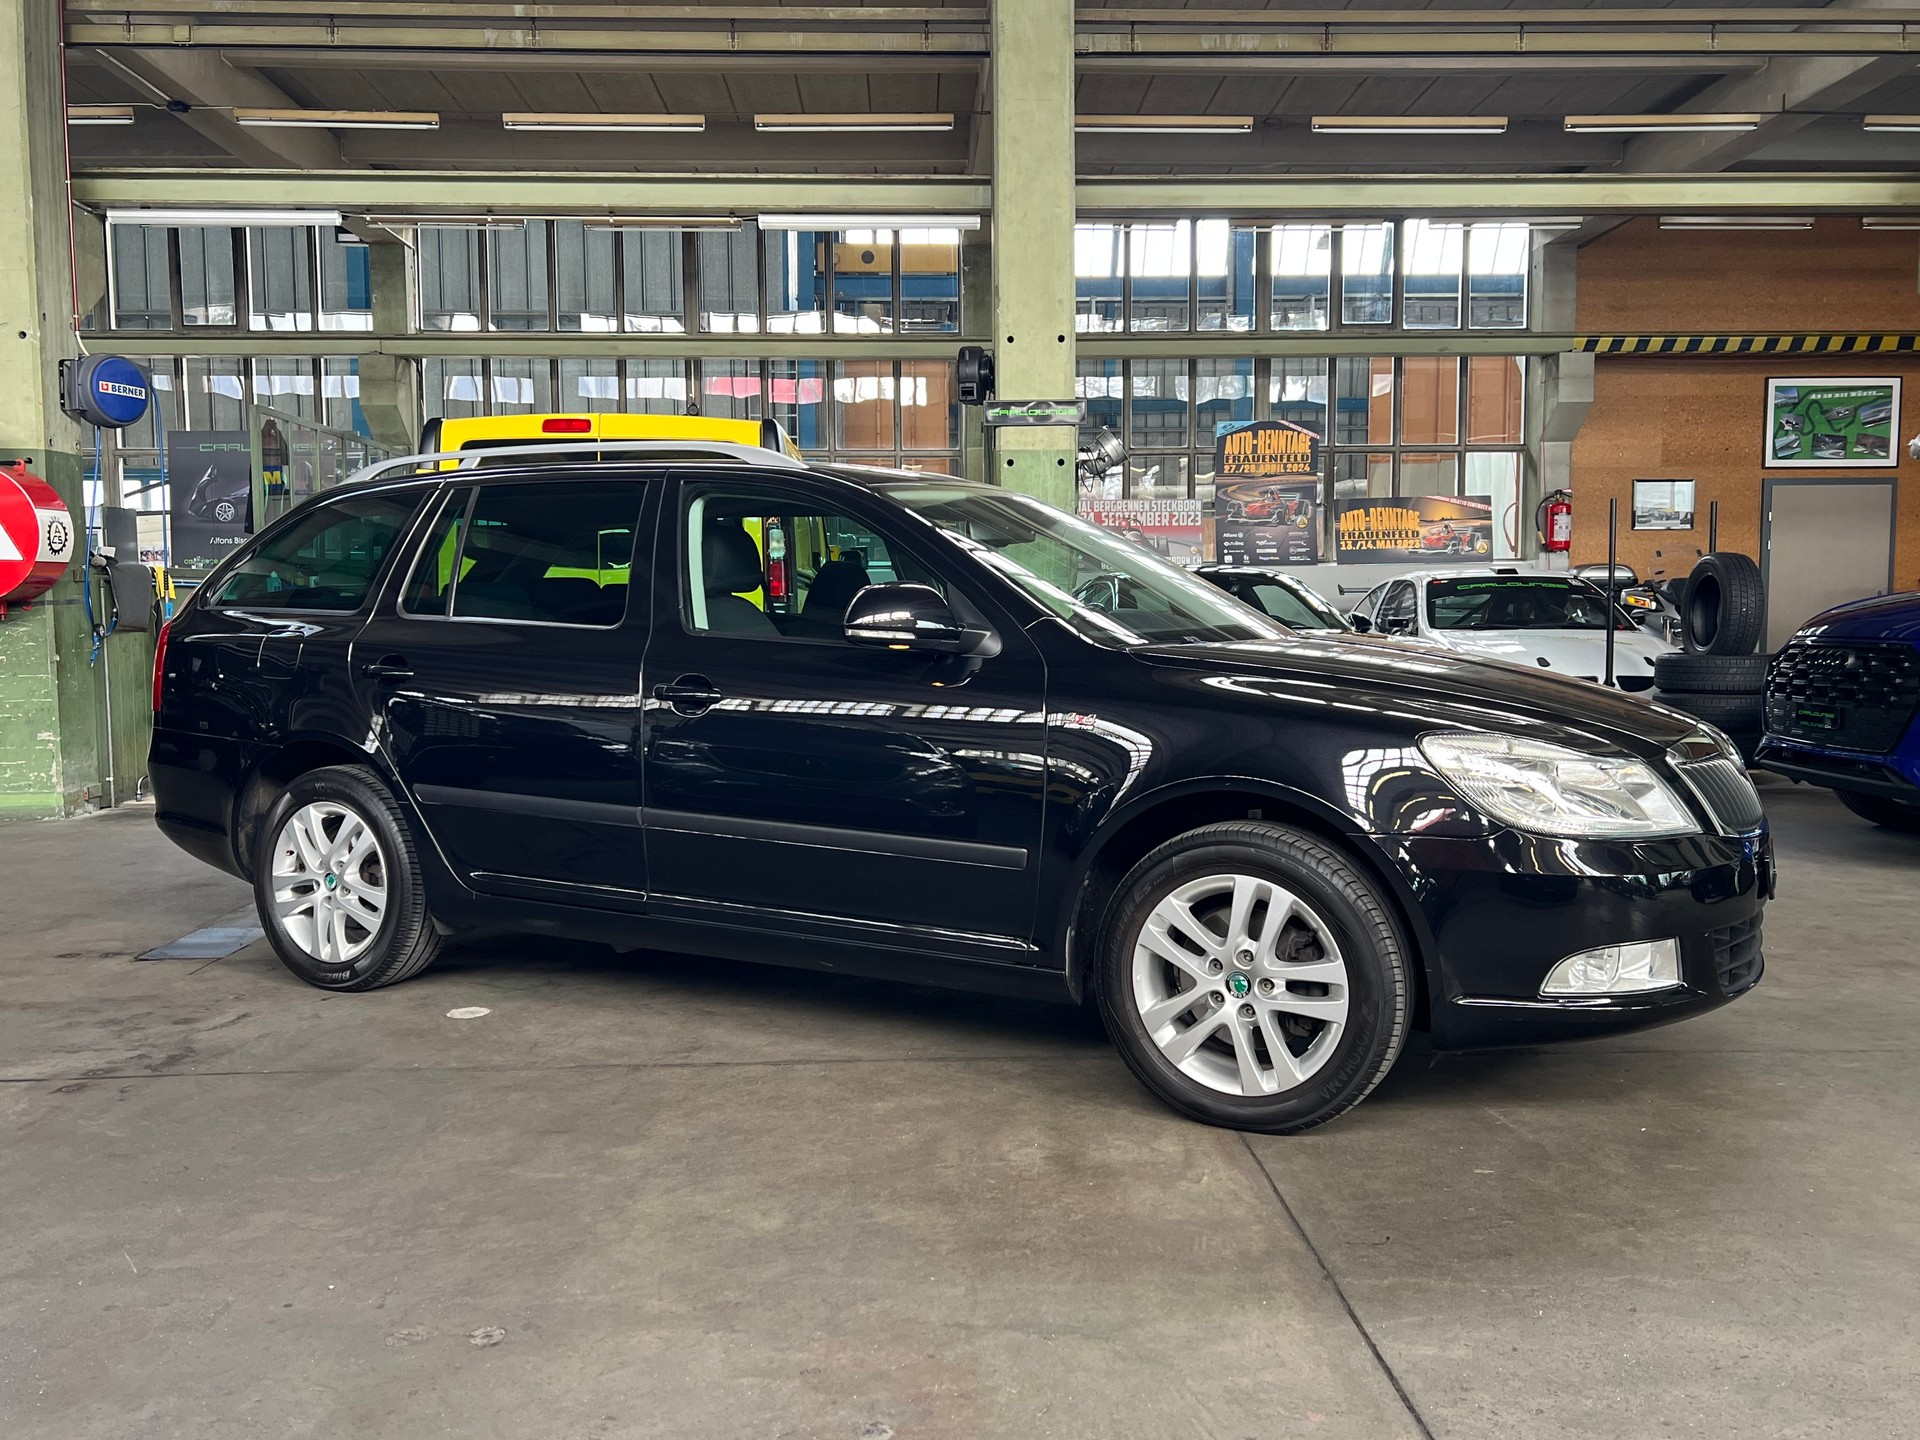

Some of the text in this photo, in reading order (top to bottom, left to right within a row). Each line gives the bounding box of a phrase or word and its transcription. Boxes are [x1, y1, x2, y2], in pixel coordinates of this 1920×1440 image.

[111, 384, 144, 398] BERNER
[989, 407, 1077, 416] CARLOUNGE
[1224, 429, 1311, 454] AUTO-RENNTAGE
[1225, 454, 1310, 463] FRAUENFELD
[1286, 463, 1310, 473] 2024
[1094, 500, 1150, 512] BERGRENNEN
[1152, 500, 1201, 512] STECKBORN
[1172, 512, 1201, 526] 2023
[1340, 507, 1421, 531] AUTO-RENNTAGE
[1341, 530, 1420, 539] FRAUENFELD
[1397, 539, 1421, 549] 2023
[1457, 582, 1569, 590] CARLOUNGE
